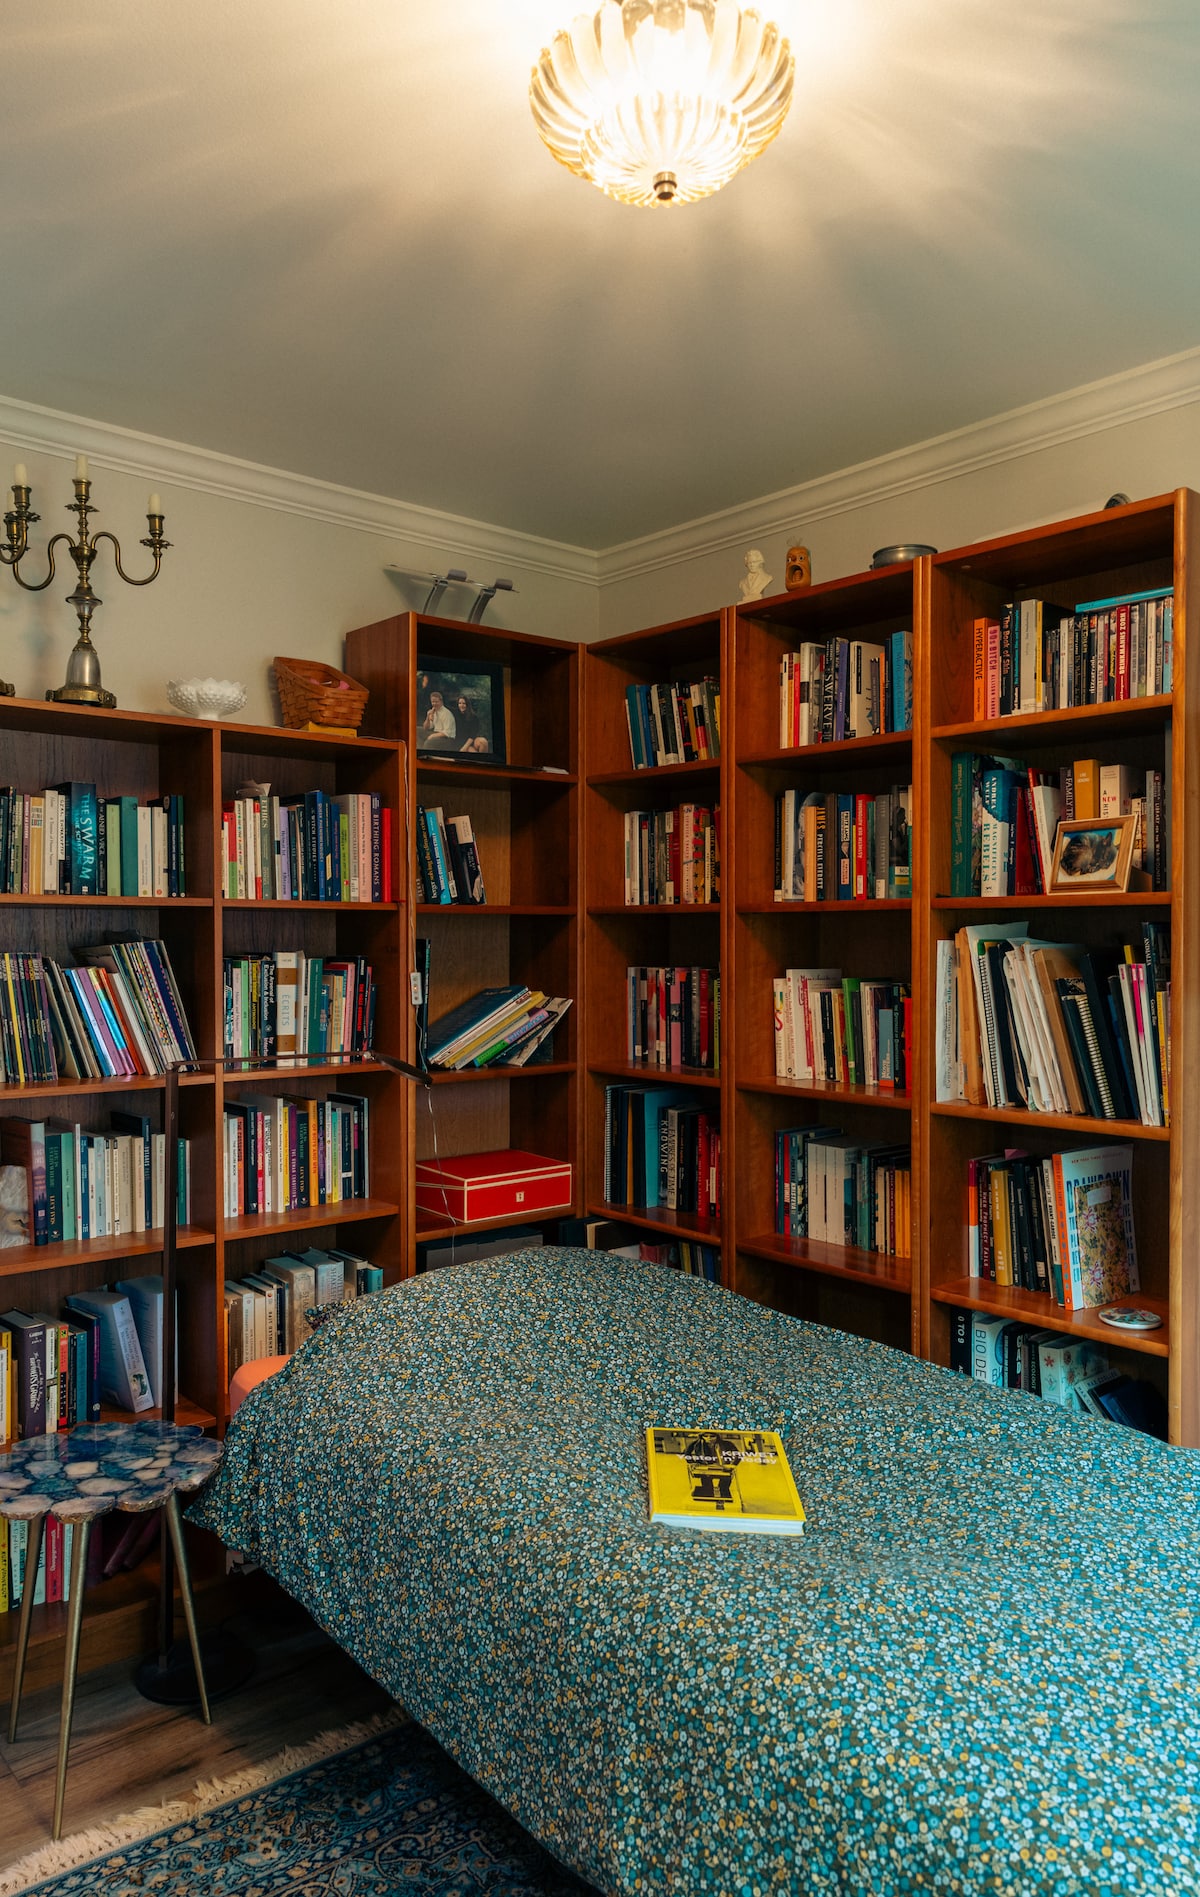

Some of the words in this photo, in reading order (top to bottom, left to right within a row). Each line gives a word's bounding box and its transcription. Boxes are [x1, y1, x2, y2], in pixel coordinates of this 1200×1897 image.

[1003, 615, 1011, 629] The
[1118, 612, 1126, 631] ZORN
[989, 629, 998, 645] 90s
[1003, 630, 1011, 648] Book
[975, 628, 983, 680] HYPERACTIVE
[989, 646, 998, 671] BITCH
[1003, 649, 1011, 657] of
[1003, 657, 1011, 674] Skin
[1118, 631, 1126, 675] BRINKMANNS
[823, 673, 833, 729] SWERVE
[81, 793, 92, 815] THE
[990, 776, 998, 810] ANDREA
[1065, 777, 1073, 806] FAMILY
[262, 799, 270, 829] ETHICS
[815, 806, 826, 831] JAMES
[79, 817, 95, 880] SWARM
[816, 833, 824, 862] PERCIVAL
[982, 823, 990, 882] REBELS
[430, 881, 438, 899] berger
[816, 863, 824, 890] EVERETT
[1143, 937, 1153, 967] ANIMALIA
[945, 1006, 953, 1035] picture
[945, 1037, 953, 1064] school
[660, 1119, 669, 1173] KNOWING
[667, 1129, 676, 1162] EMPIRES
[668, 1174, 676, 1196] TIME
[957, 1323, 965, 1337] TO
[676, 1454, 717, 1462] Yester
[738, 1456, 778, 1465] Today
